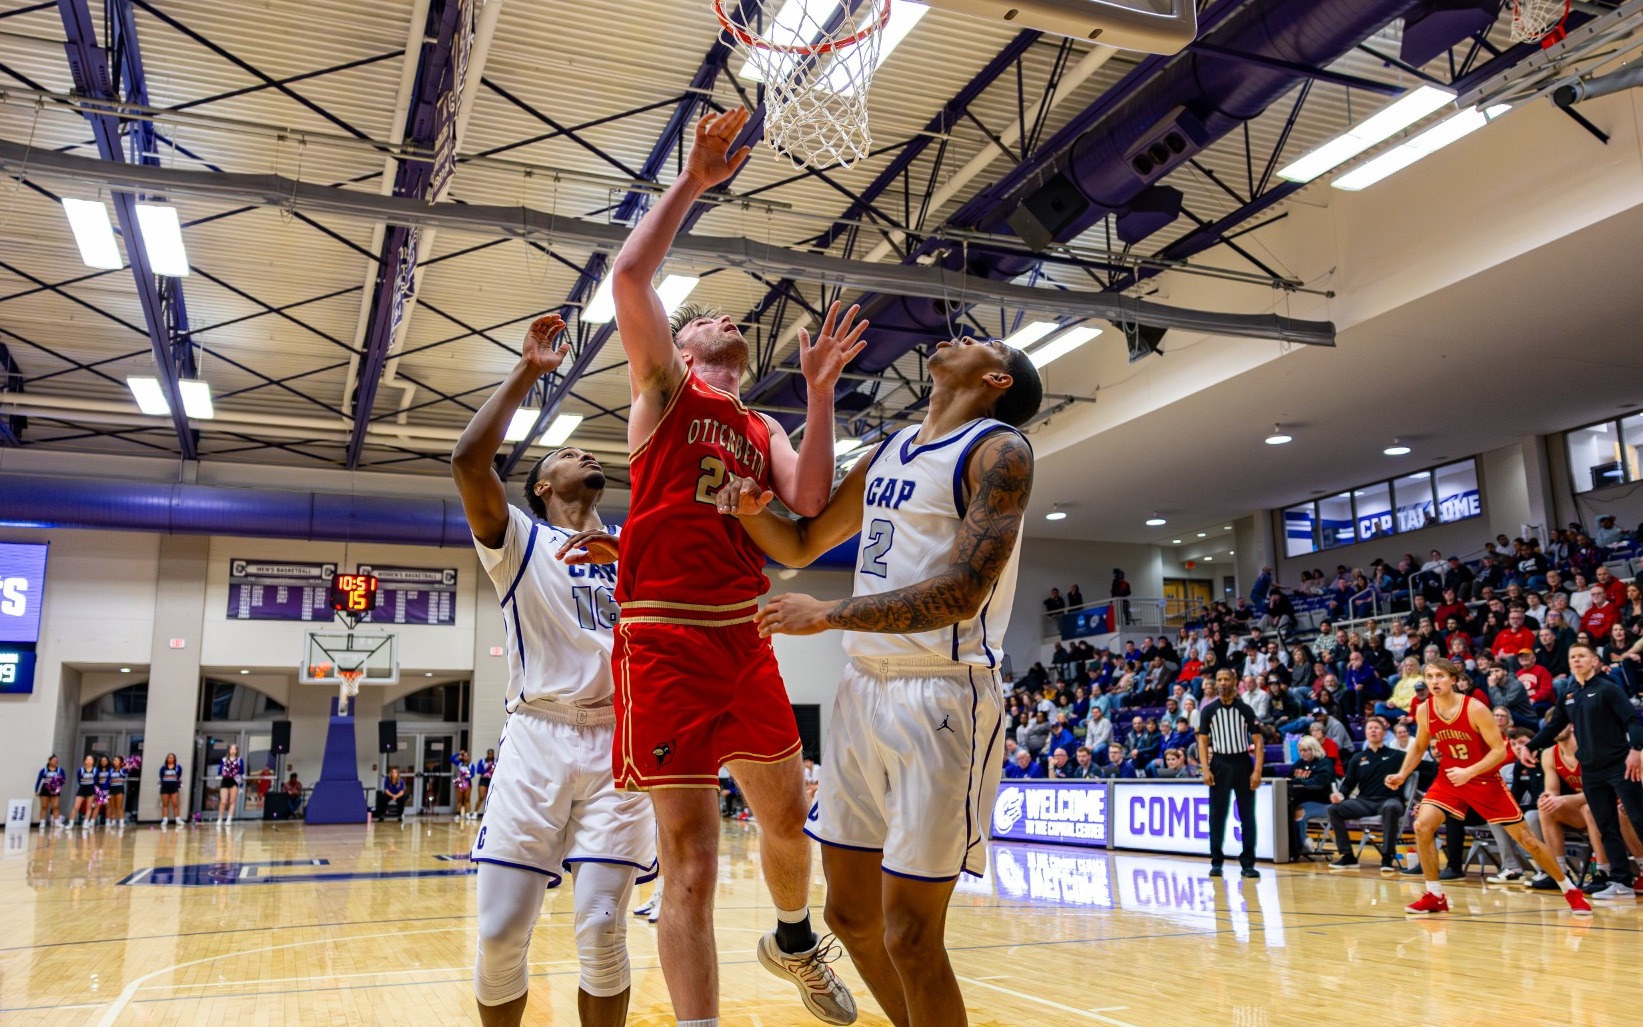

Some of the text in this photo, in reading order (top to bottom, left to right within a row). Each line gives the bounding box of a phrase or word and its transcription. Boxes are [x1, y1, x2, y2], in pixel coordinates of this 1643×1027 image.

[687, 418, 766, 481] OTTERBEIN
[695, 454, 734, 506] 2
[866, 476, 917, 511] CAP
[860, 518, 896, 579] 2
[0, 576, 28, 616] S
[339, 576, 375, 591] 10:51
[349, 590, 366, 610] 15
[0, 663, 15, 682] 9
[1449, 743, 1469, 760] 12
[1025, 788, 1105, 823] WELCOME
[477, 826, 487, 849] C
[1048, 821, 1076, 838] CAPITAL
